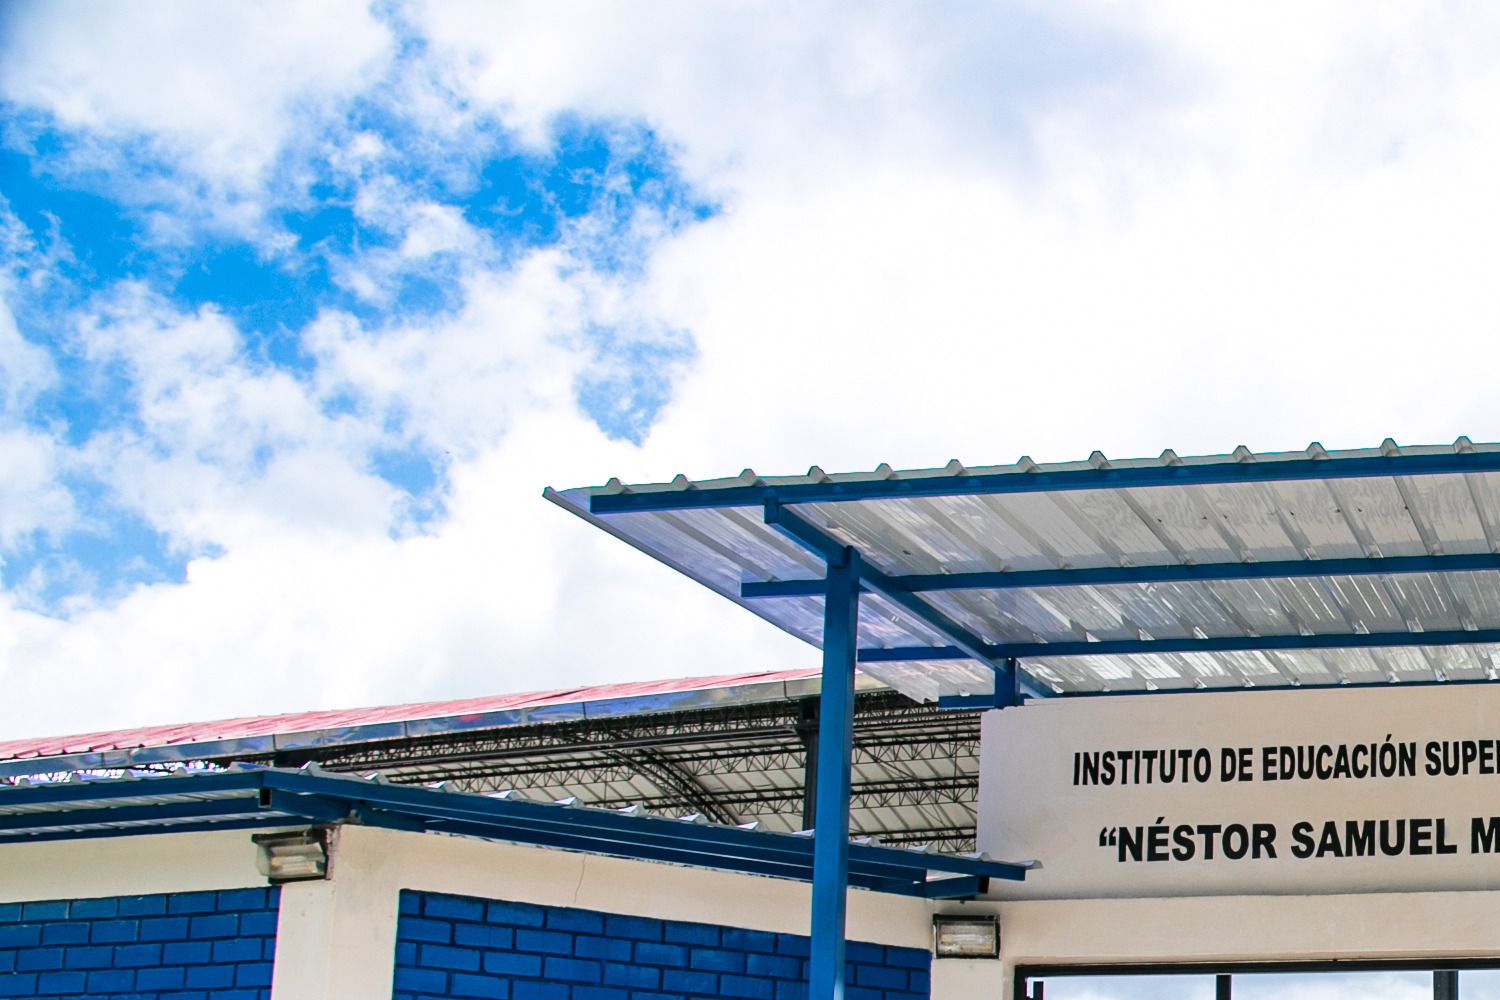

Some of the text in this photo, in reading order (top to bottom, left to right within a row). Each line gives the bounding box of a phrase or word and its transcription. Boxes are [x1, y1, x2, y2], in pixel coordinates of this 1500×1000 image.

[1073, 747, 1212, 786] INSTITUTO
[1220, 747, 1254, 783] DE
[1262, 733, 1417, 782] EDUCACIÓN
[1290, 817, 1458, 860] SAMUEL
